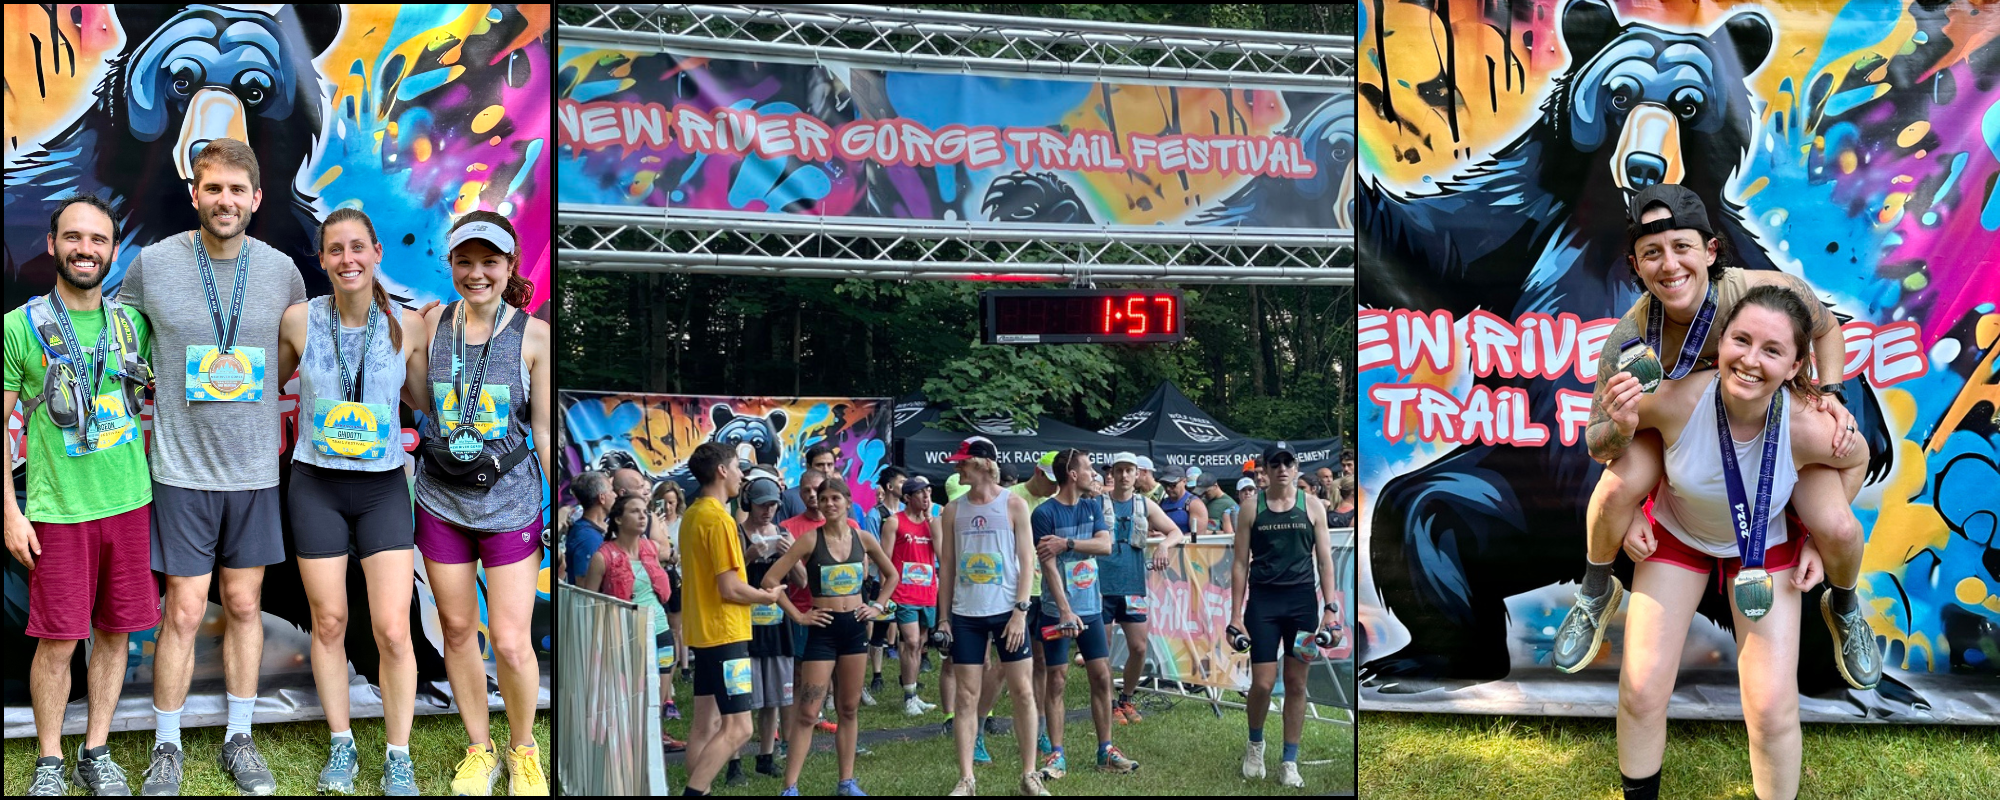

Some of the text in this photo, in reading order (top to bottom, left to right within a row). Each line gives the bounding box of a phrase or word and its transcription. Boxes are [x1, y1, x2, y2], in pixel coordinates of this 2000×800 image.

[558, 103, 663, 146] NEW
[843, 123, 1001, 166] GORGE
[1358, 314, 1449, 371] EW
[75, 446, 87, 454] 475
[1166, 454, 1196, 465] WOLF
[1198, 454, 1232, 466] CREEK
[1735, 502, 1749, 539] 2024
